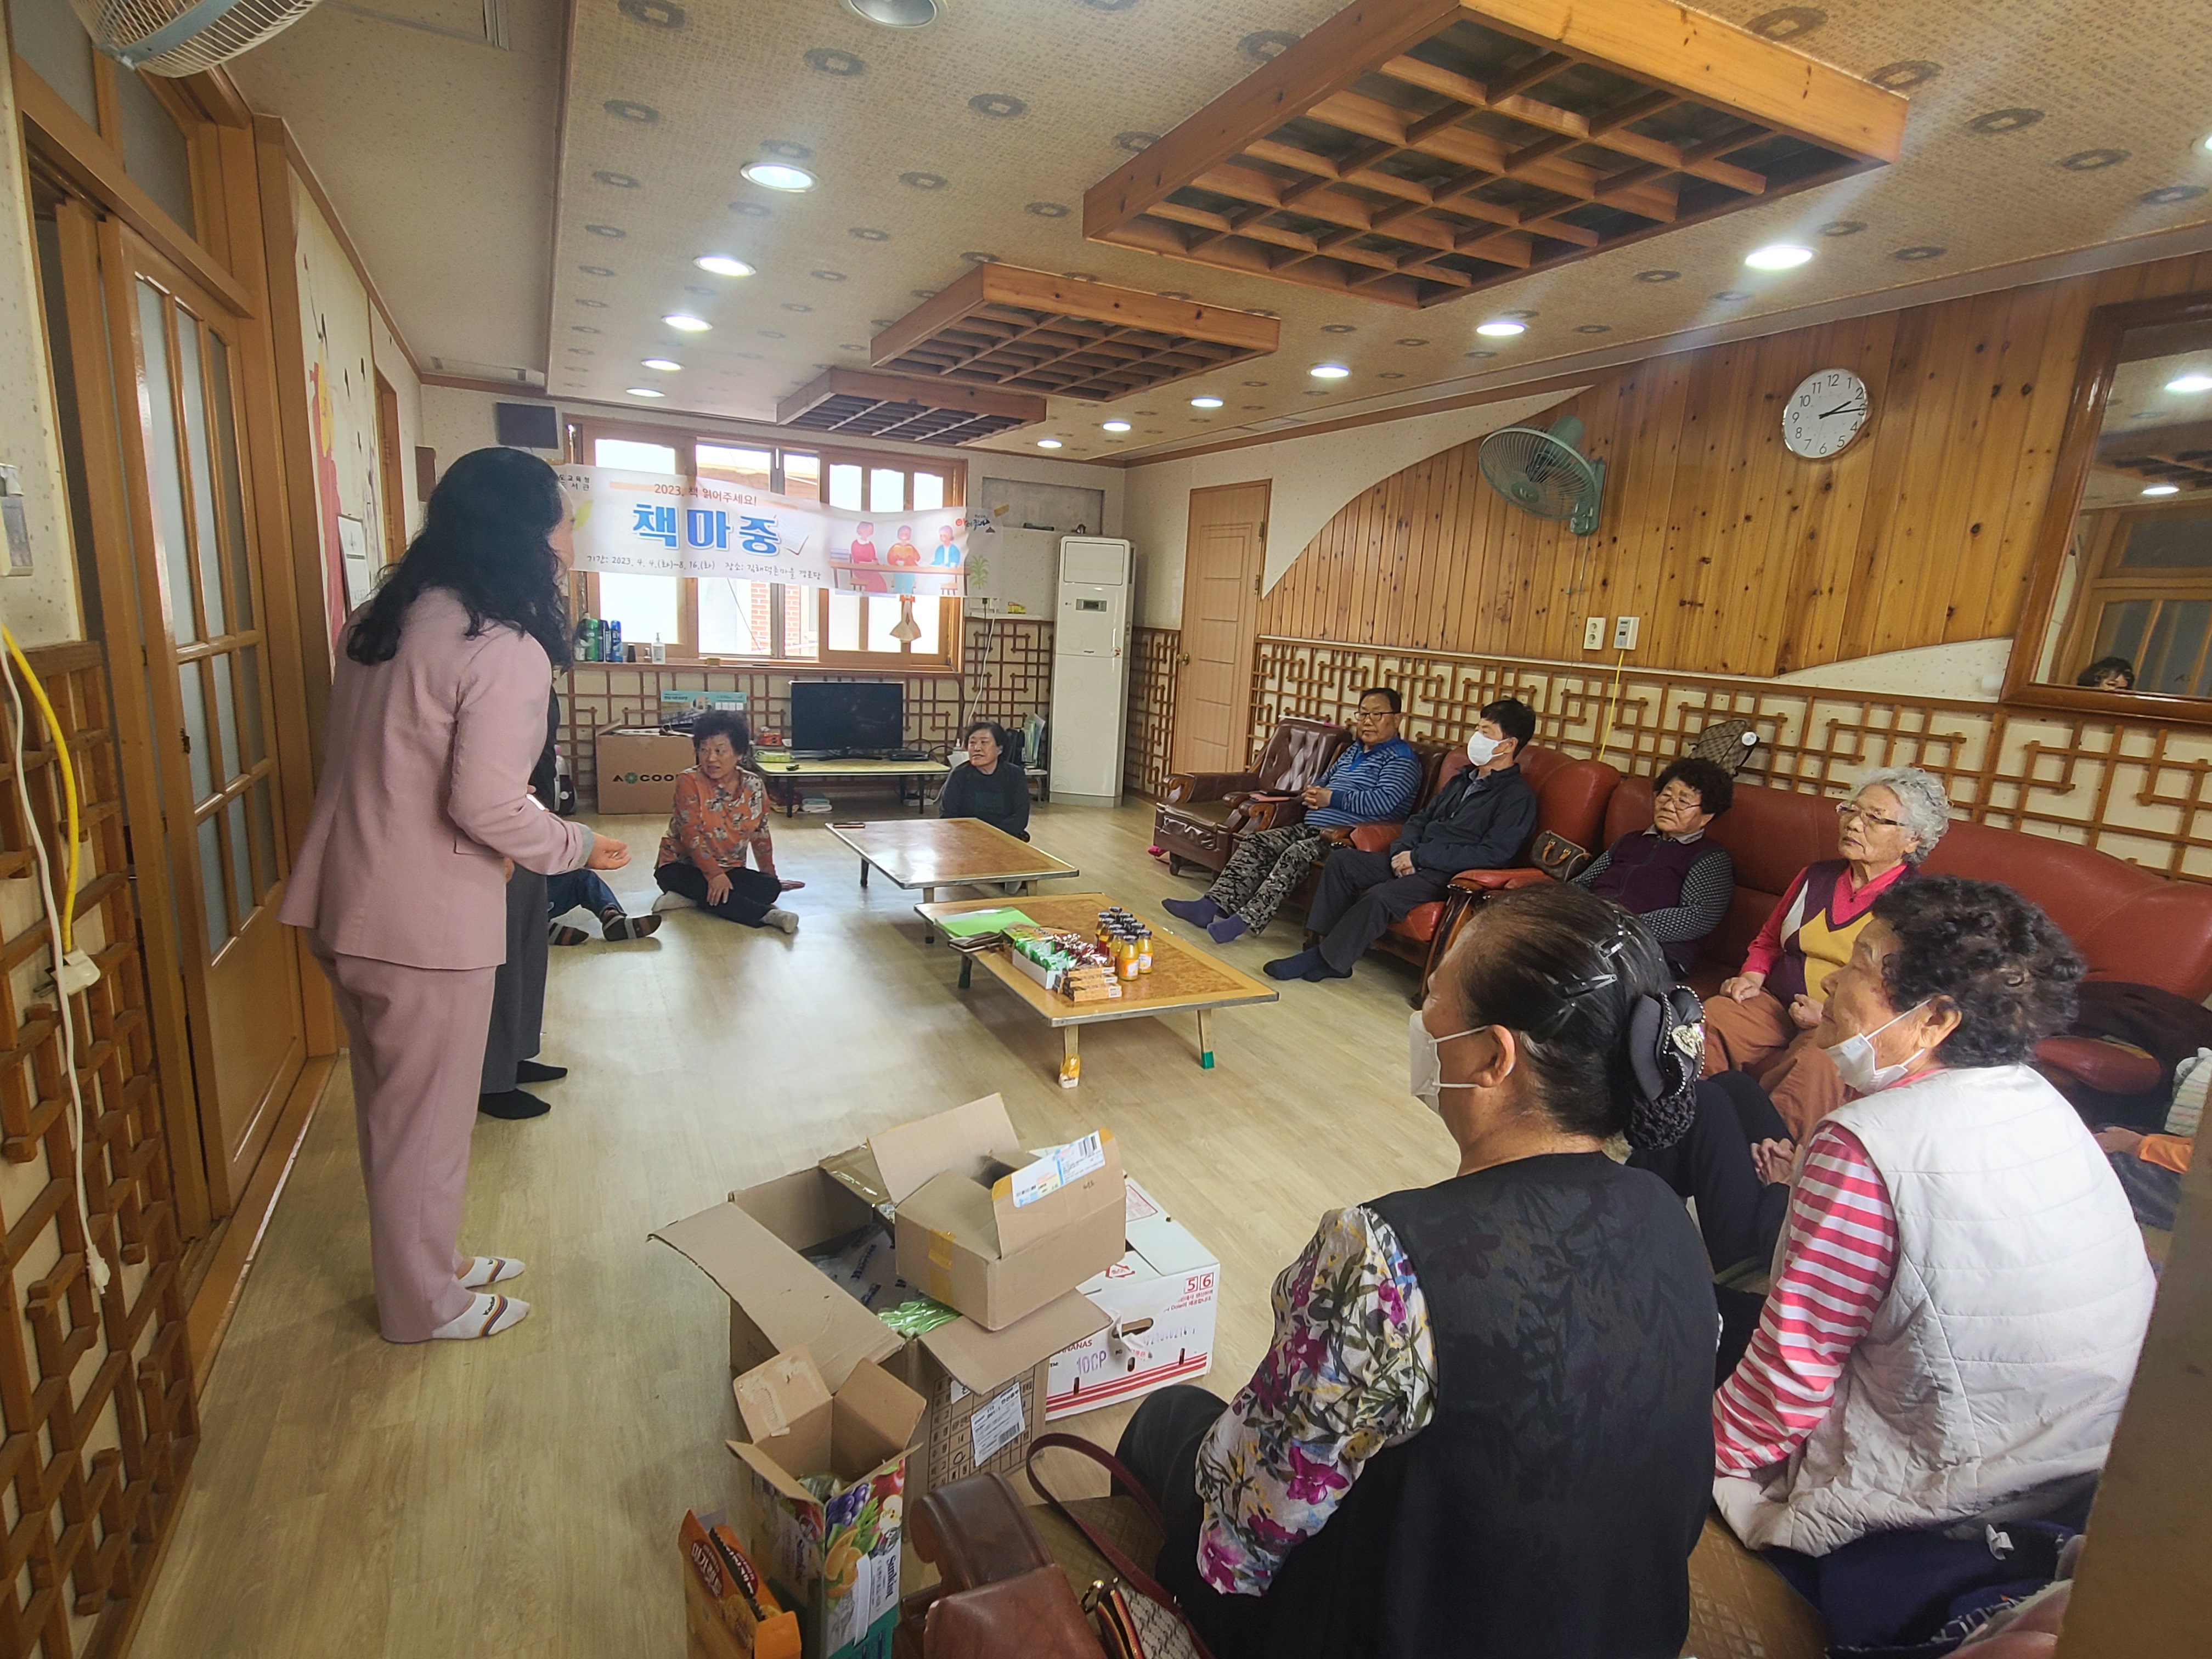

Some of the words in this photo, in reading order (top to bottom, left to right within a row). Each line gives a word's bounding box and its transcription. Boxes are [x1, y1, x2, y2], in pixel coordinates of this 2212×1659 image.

[1828, 374, 1839, 387] 12
[1847, 377, 1852, 389] 1
[1812, 382, 1821, 394] 11
[1855, 387, 1864, 400] 2
[1799, 395, 1810, 407] 10
[1858, 404, 1866, 416] 3
[1792, 412, 1799, 424] 9
[1850, 421, 1858, 432] 4
[1795, 427, 1802, 439] 8
[1804, 439, 1812, 451] 7
[1837, 435, 1846, 448] 5
[1819, 443, 1827, 454] 6
[654, 484, 684, 496] 2023.
[688, 487, 699, 498] 책
[702, 488, 757, 506] 읽어주세요!
[633, 504, 779, 555] 책마중
[587, 555, 608, 564] 기간:
[612, 556, 634, 566] 2023.
[725, 562, 743, 571] 장소:
[1187, 1278, 1195, 1291] 5
[1203, 1274, 1211, 1288] 6
